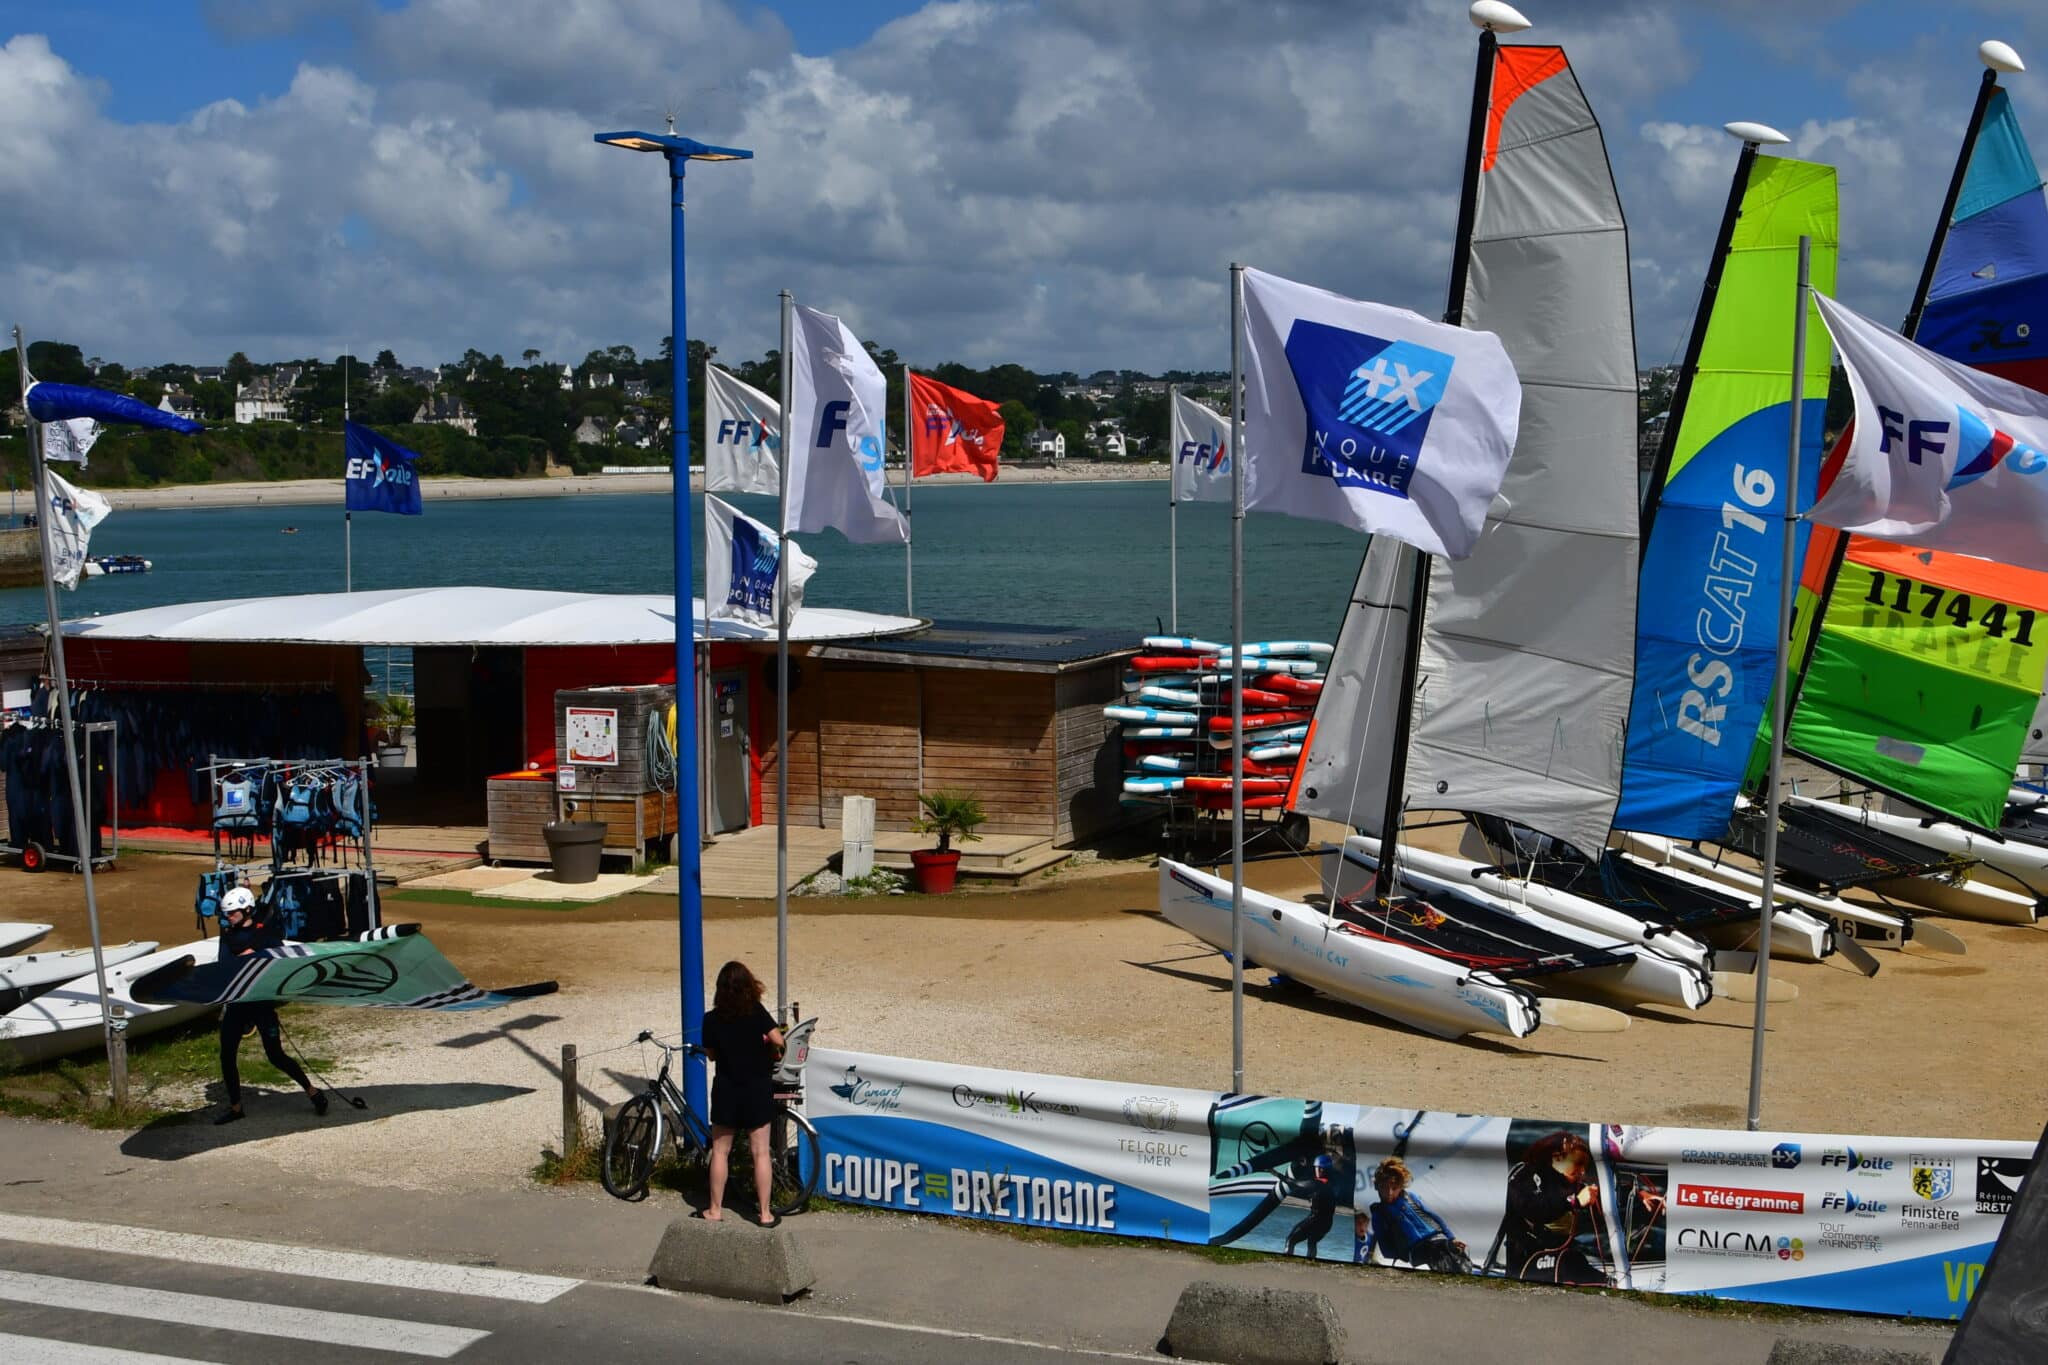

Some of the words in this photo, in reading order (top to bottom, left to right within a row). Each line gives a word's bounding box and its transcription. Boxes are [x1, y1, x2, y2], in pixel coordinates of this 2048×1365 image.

[1314, 430, 1409, 470] NQUE
[1864, 570, 2036, 647] 117441
[1118, 1138, 1189, 1158] TELGRUC
[1682, 1150, 1726, 1160] GRAND
[1728, 1152, 1769, 1161] OUEST
[1720, 1159, 1768, 1168] POPULAIRE
[825, 1152, 921, 1206] COUPE
[951, 1167, 1116, 1229] BRETAGNE
[1680, 1188, 1699, 1203] Le
[1702, 1189, 1800, 1211] Télégramme
[1979, 1191, 2013, 1201] Région
[1901, 1204, 1960, 1222] Finistère
[1819, 1222, 1847, 1233] TOUT
[1901, 1219, 1960, 1232] Penn-ar-Bed
[1678, 1228, 1772, 1252] CNCM
[1822, 1231, 1881, 1242] commence
